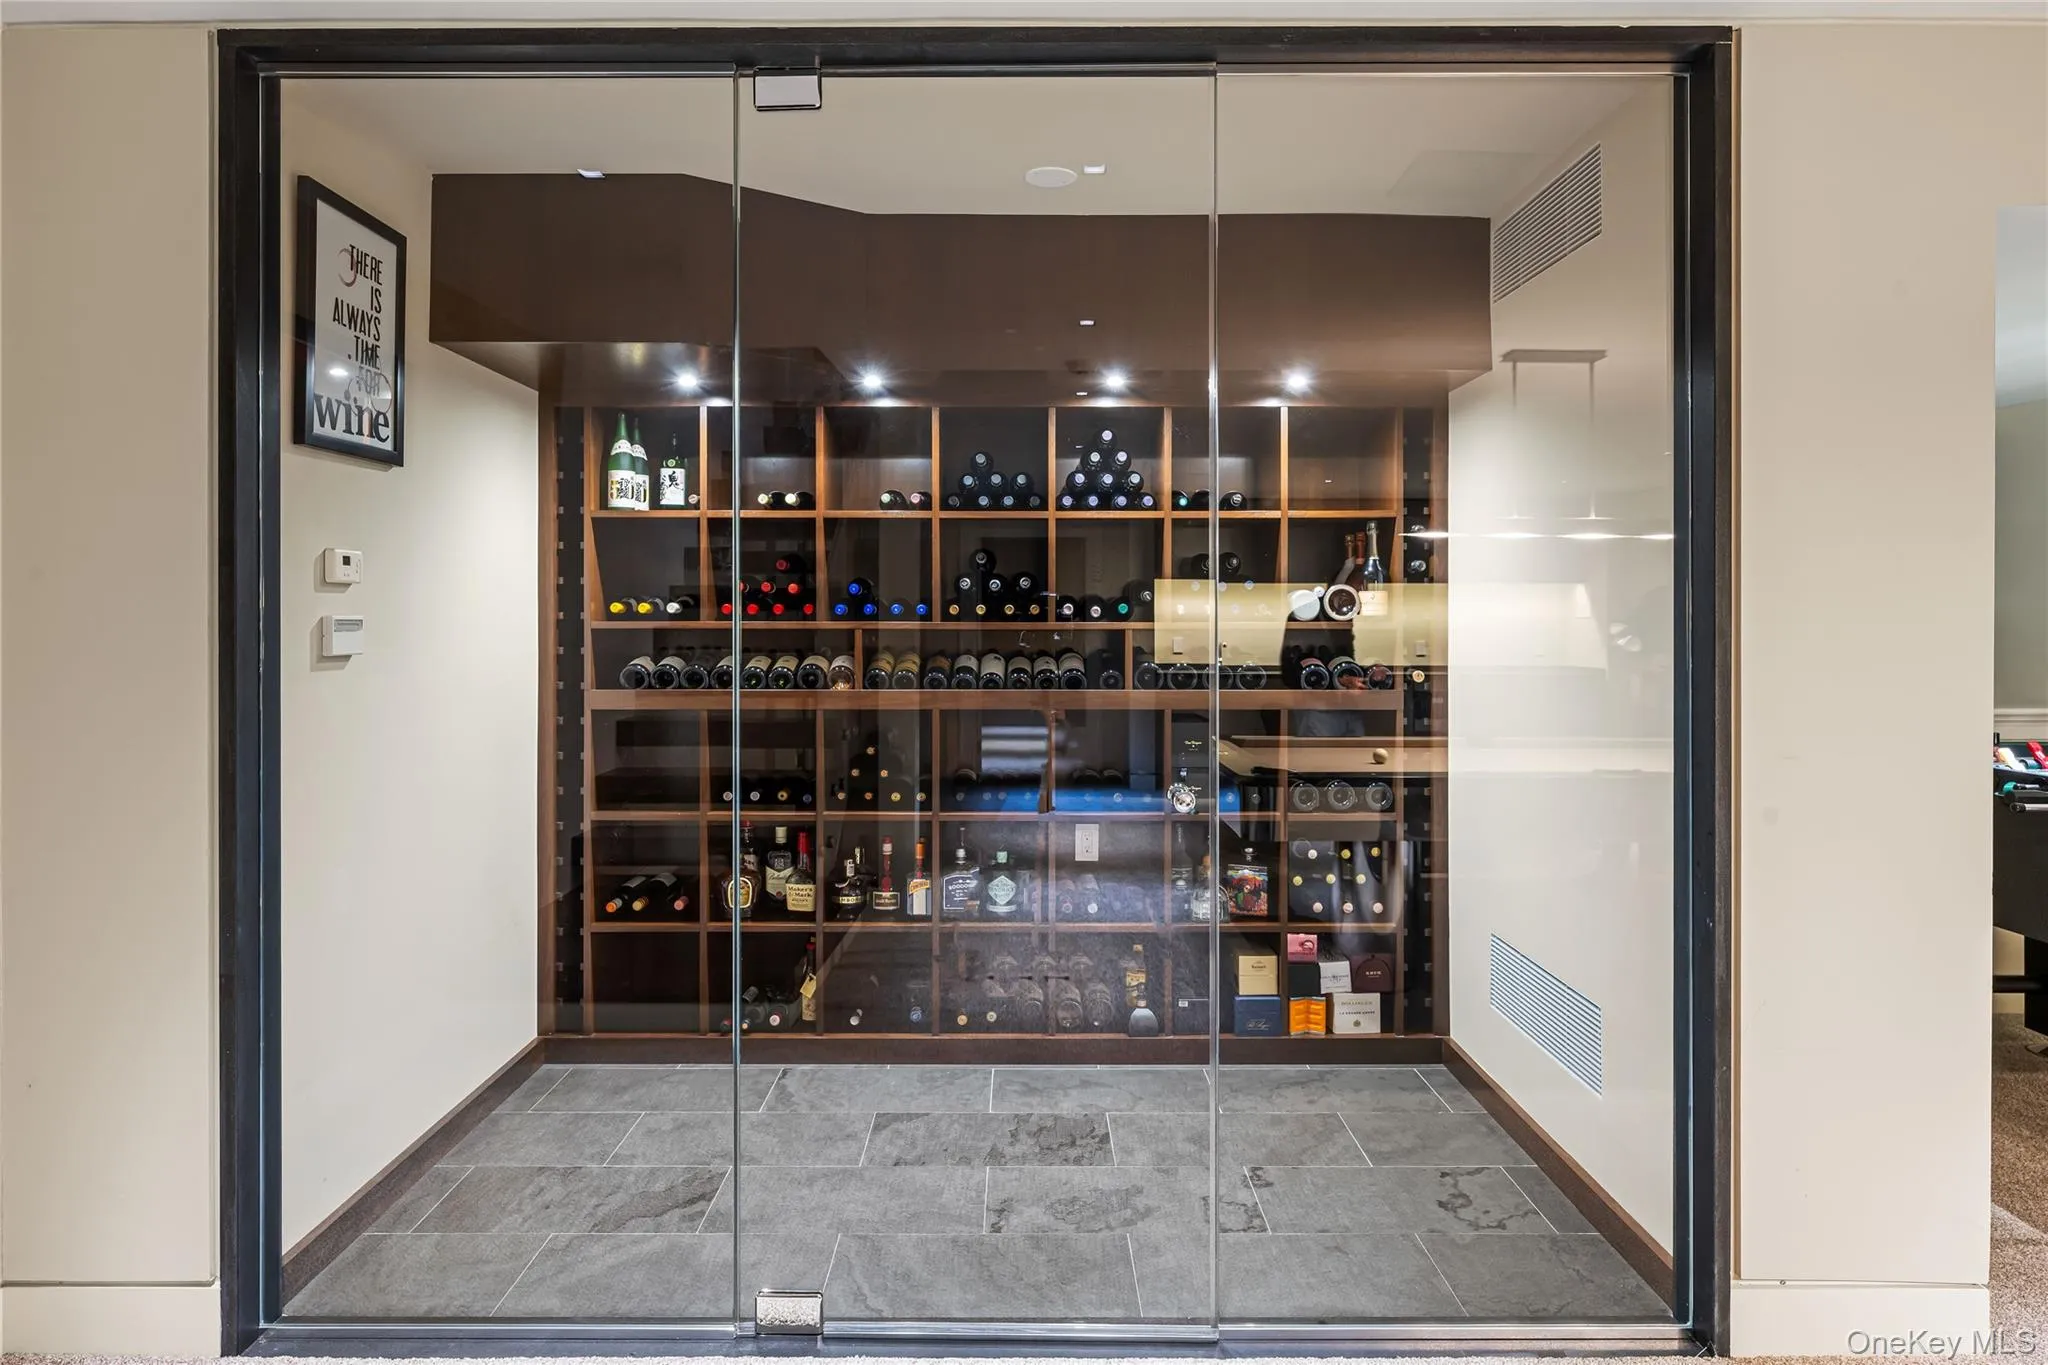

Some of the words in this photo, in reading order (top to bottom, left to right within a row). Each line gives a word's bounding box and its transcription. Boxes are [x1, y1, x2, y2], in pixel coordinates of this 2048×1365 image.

[349, 244, 383, 286] THERE
[332, 296, 381, 342] ALWAYS
[370, 285, 382, 315] IS
[354, 335, 380, 371] TIME
[314, 392, 390, 443] wine
